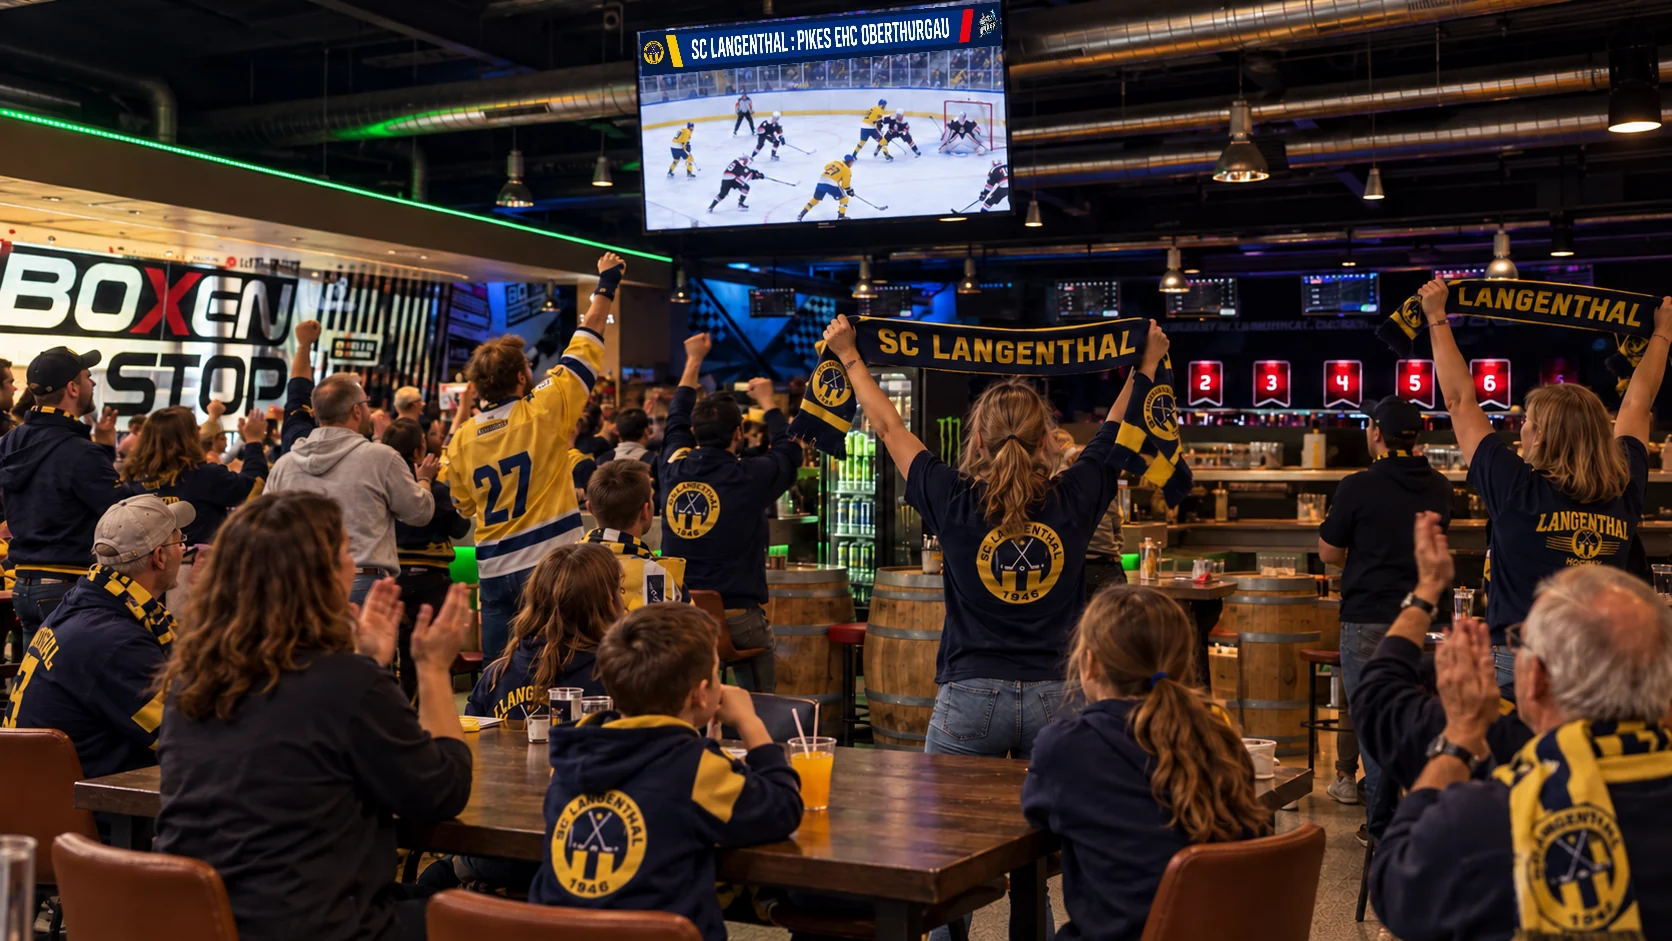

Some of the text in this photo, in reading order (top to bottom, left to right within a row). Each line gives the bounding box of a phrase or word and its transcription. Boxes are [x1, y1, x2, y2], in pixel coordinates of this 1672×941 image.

[691, 39, 708, 59] SC
[710, 31, 789, 58] LANGENTHAL
[791, 36, 795, 51] :
[797, 27, 832, 51] PIKES
[834, 25, 858, 49] EHC
[861, 17, 950, 45] OBERTHURGAU
[0, 252, 293, 340] BOXEN
[1458, 287, 1641, 327] LANGENTHAL
[878, 328, 1136, 365] SC LANGENTHAL
[103, 352, 288, 416] STOP
[1200, 375, 1211, 391] 2
[1266, 374, 1277, 391] 3
[1336, 375, 1348, 391] 4
[1409, 374, 1421, 392] 5
[1483, 374, 1496, 392] 6
[473, 451, 532, 526] 27
[1535, 511, 1629, 540] LANGENTHAL
[981, 524, 1062, 561] SC LAENTHAL
[1003, 589, 1039, 601] 1946
[570, 878, 610, 894] 1946
